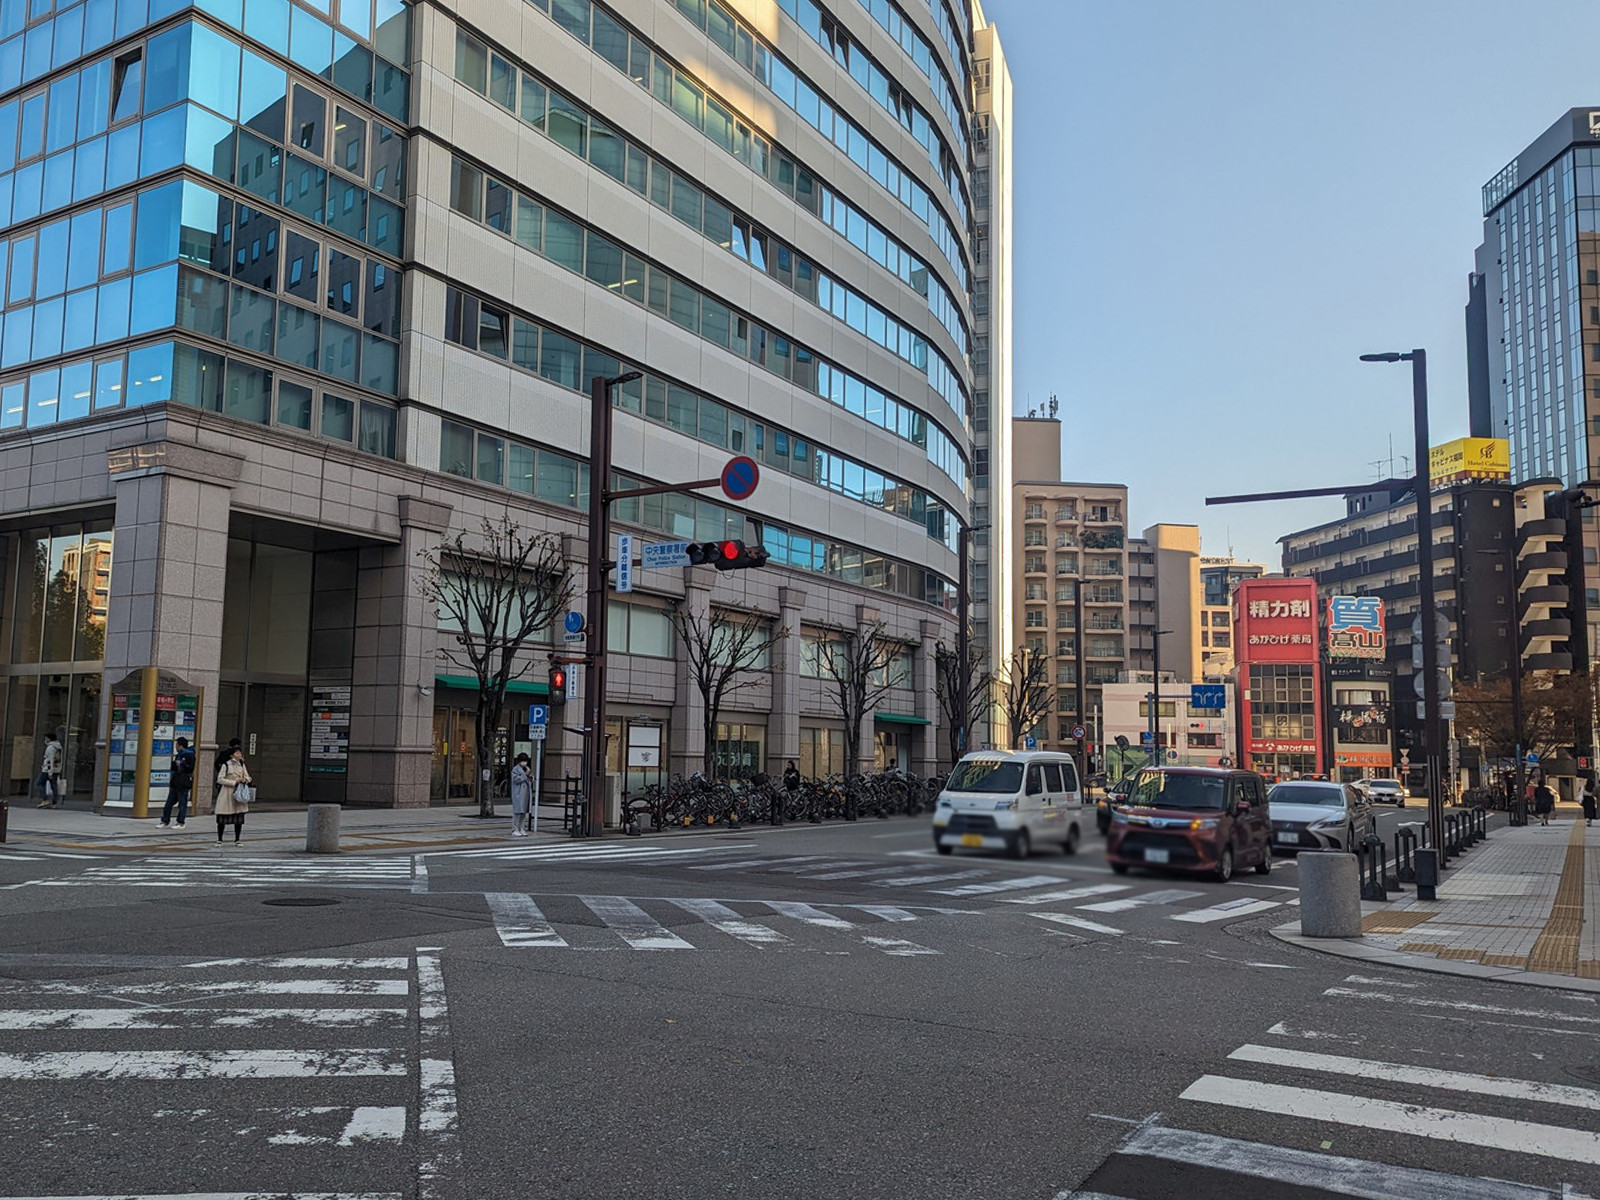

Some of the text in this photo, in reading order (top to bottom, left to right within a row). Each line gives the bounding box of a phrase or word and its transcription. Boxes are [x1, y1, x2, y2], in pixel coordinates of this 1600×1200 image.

[1249, 599, 1311, 618] 精力剤
[1330, 596, 1382, 631] 質
[533, 707, 544, 723] P
[1027, 737, 1035, 747] P
